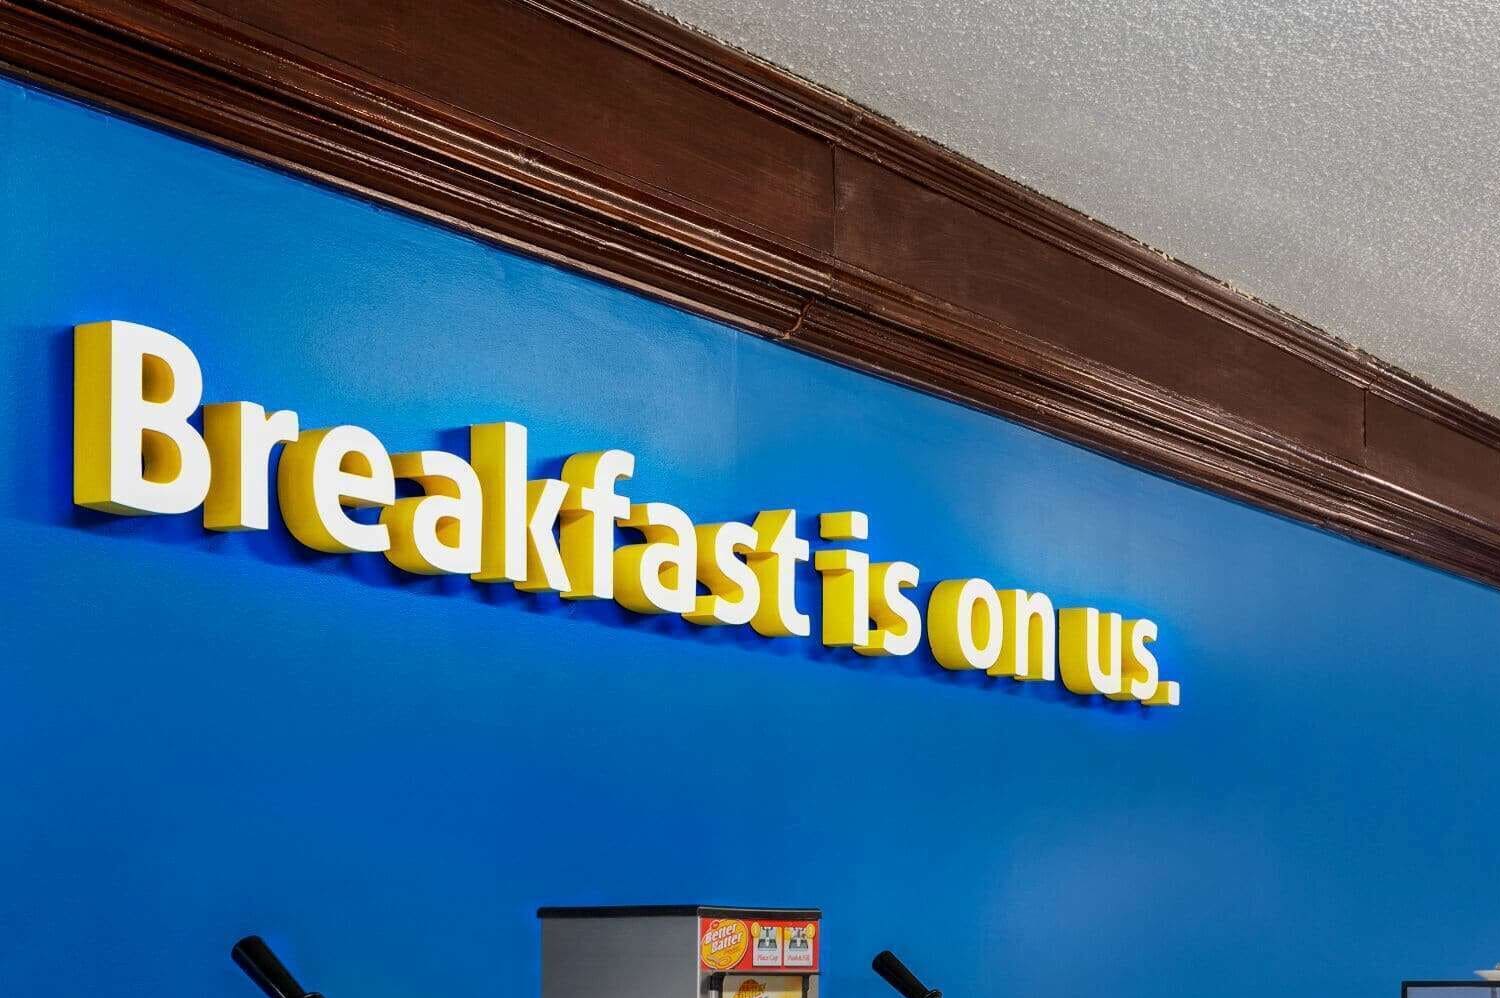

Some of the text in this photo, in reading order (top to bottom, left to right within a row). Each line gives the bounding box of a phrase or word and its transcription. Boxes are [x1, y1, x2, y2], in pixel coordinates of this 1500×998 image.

[74, 320, 1180, 707] Breakfast is on us.
[704, 924, 737, 945] Better
[711, 932, 742, 953] Batter
